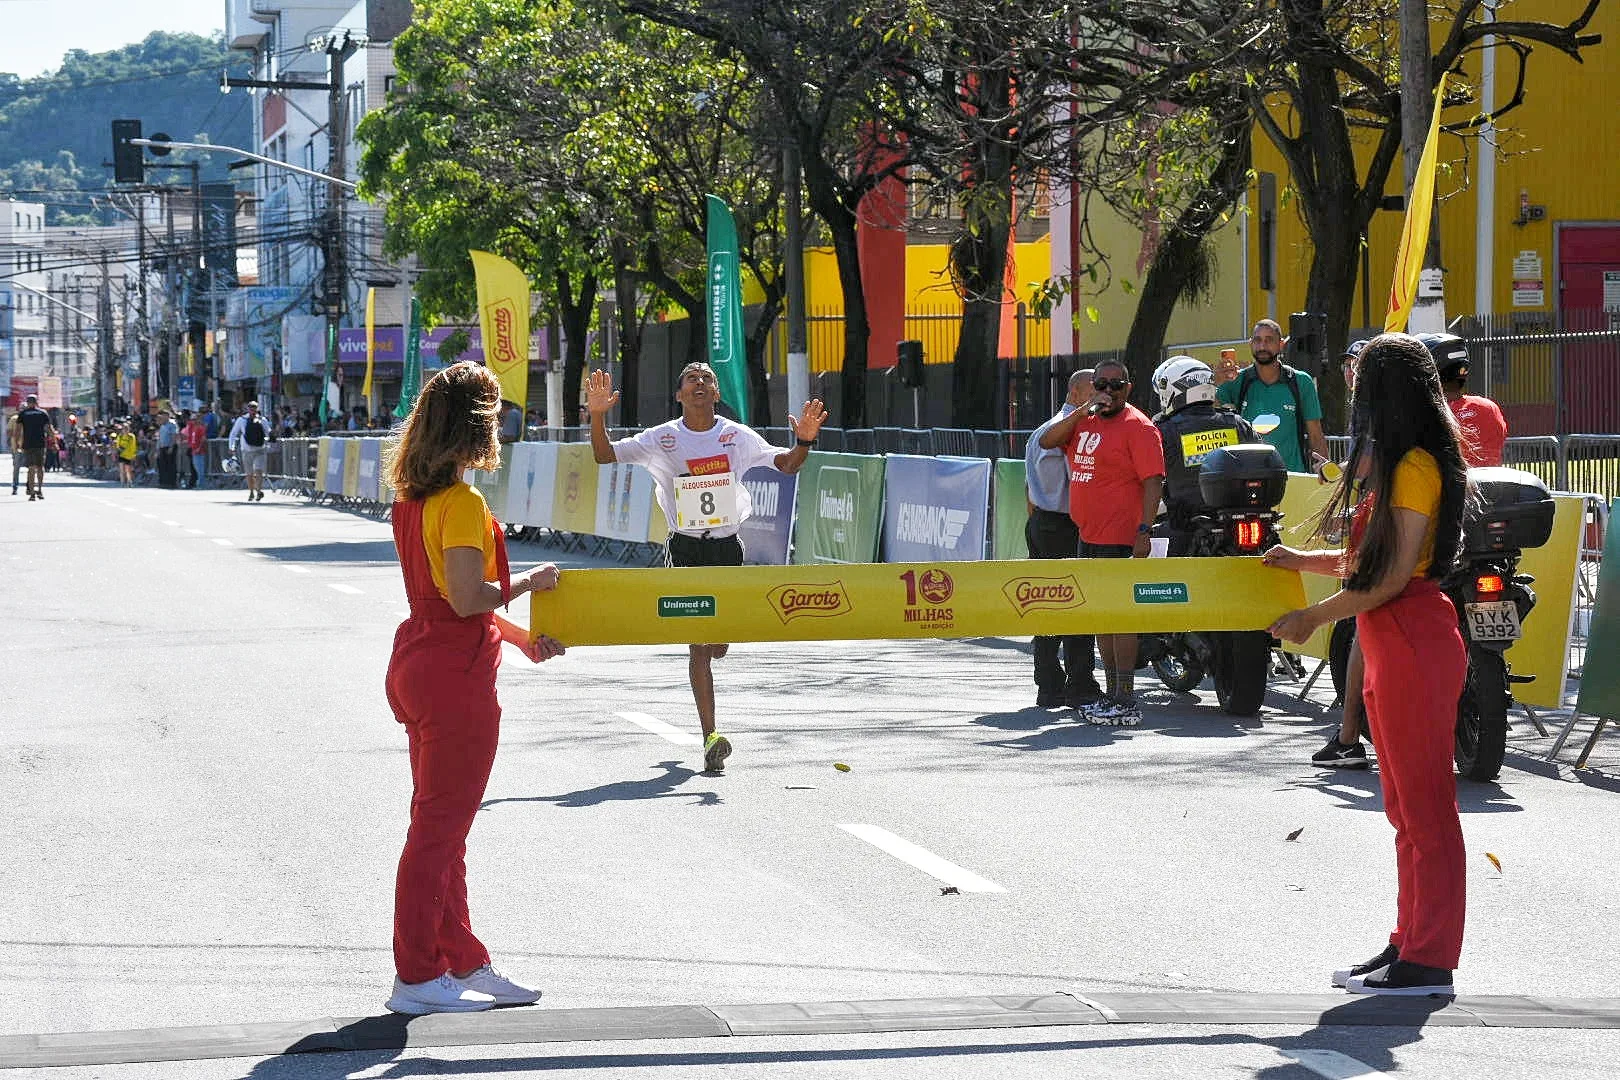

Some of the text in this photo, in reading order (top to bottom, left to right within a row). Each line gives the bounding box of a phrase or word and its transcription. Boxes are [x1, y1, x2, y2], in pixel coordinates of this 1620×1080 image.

[493, 308, 515, 362] Garoto
[1195, 431, 1228, 443] POLÍCIA
[1071, 471, 1093, 483] STAFF
[700, 491, 716, 516] 8
[1016, 581, 1075, 608] Garoto
[1138, 587, 1172, 596] Unimed
[663, 600, 699, 609] Unimed
[780, 588, 841, 615] Garoto
[904, 608, 954, 622] MILHAS
[1475, 624, 1516, 638] 9392
